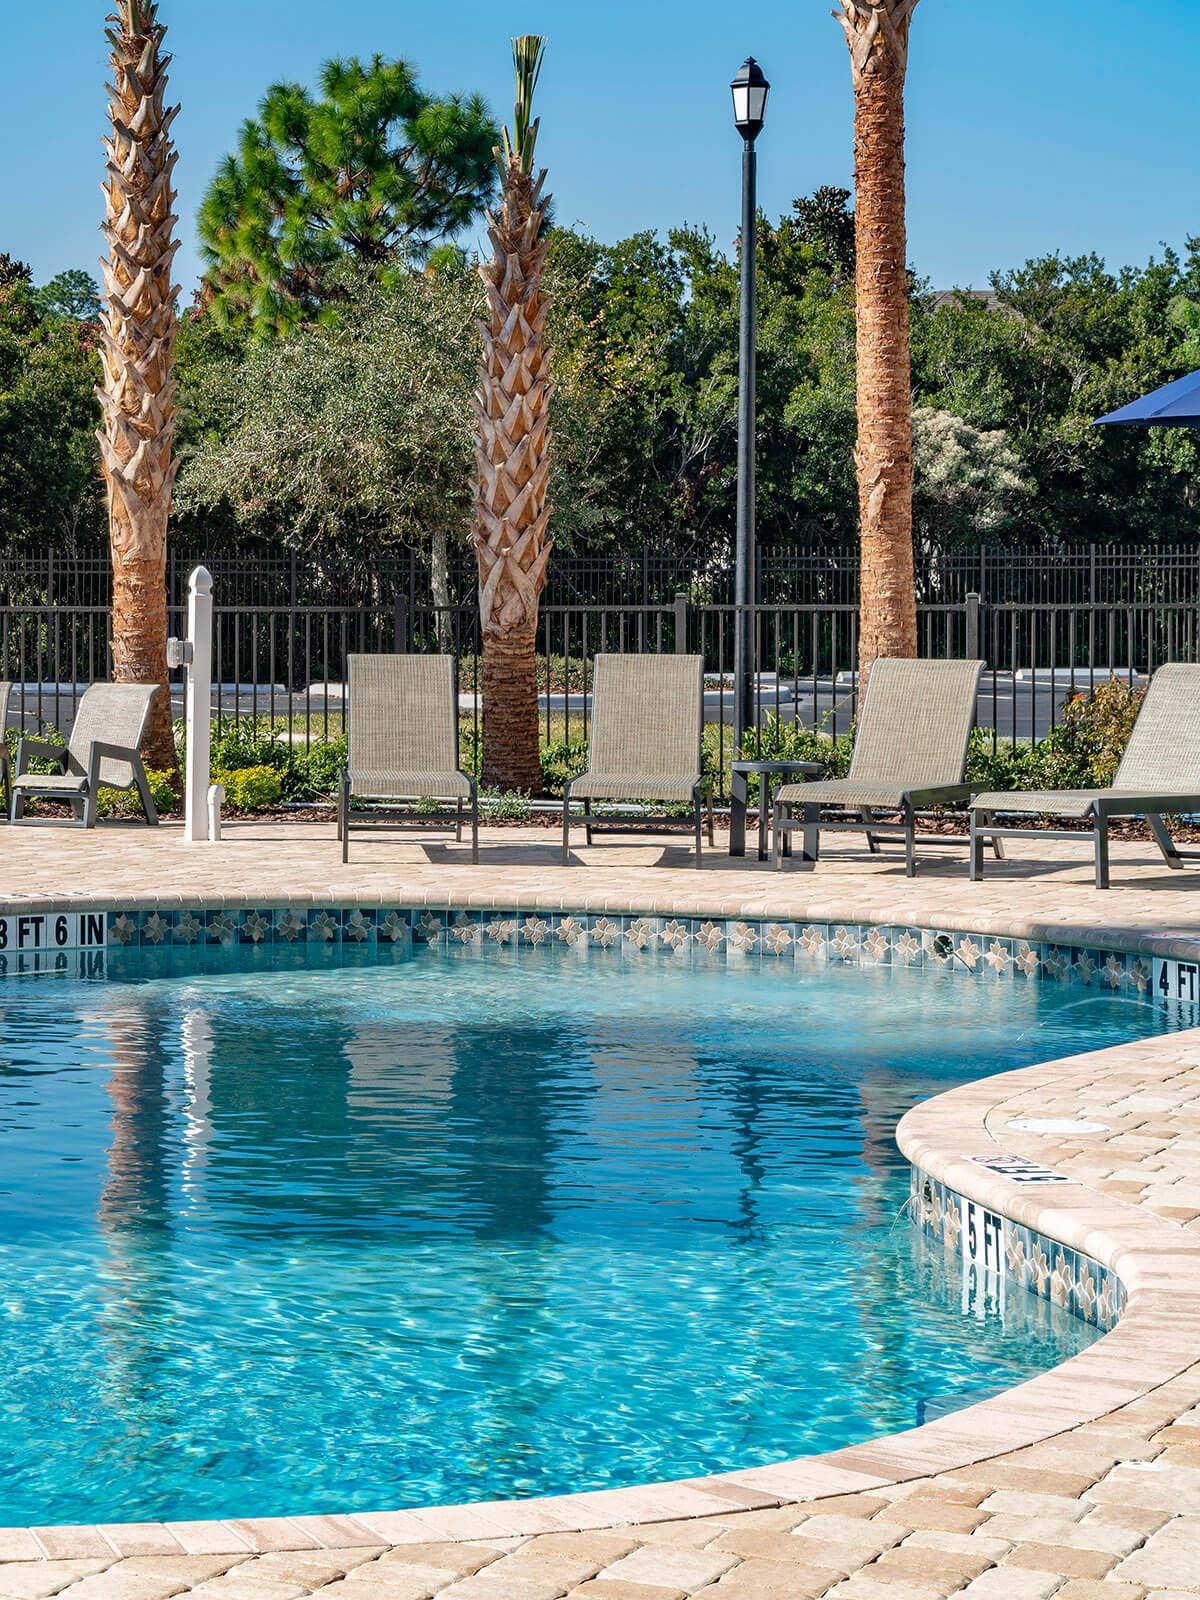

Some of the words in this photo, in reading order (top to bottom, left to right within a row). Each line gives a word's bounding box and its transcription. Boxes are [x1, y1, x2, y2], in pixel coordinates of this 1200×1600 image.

[18, 917, 44, 947] FT
[55, 916, 67, 945] 6
[80, 915, 103, 945] IN
[1160, 961, 1169, 996] 4
[1178, 963, 1196, 1000] FT
[968, 1202, 977, 1259] 5
[984, 1210, 1002, 1273] FT
